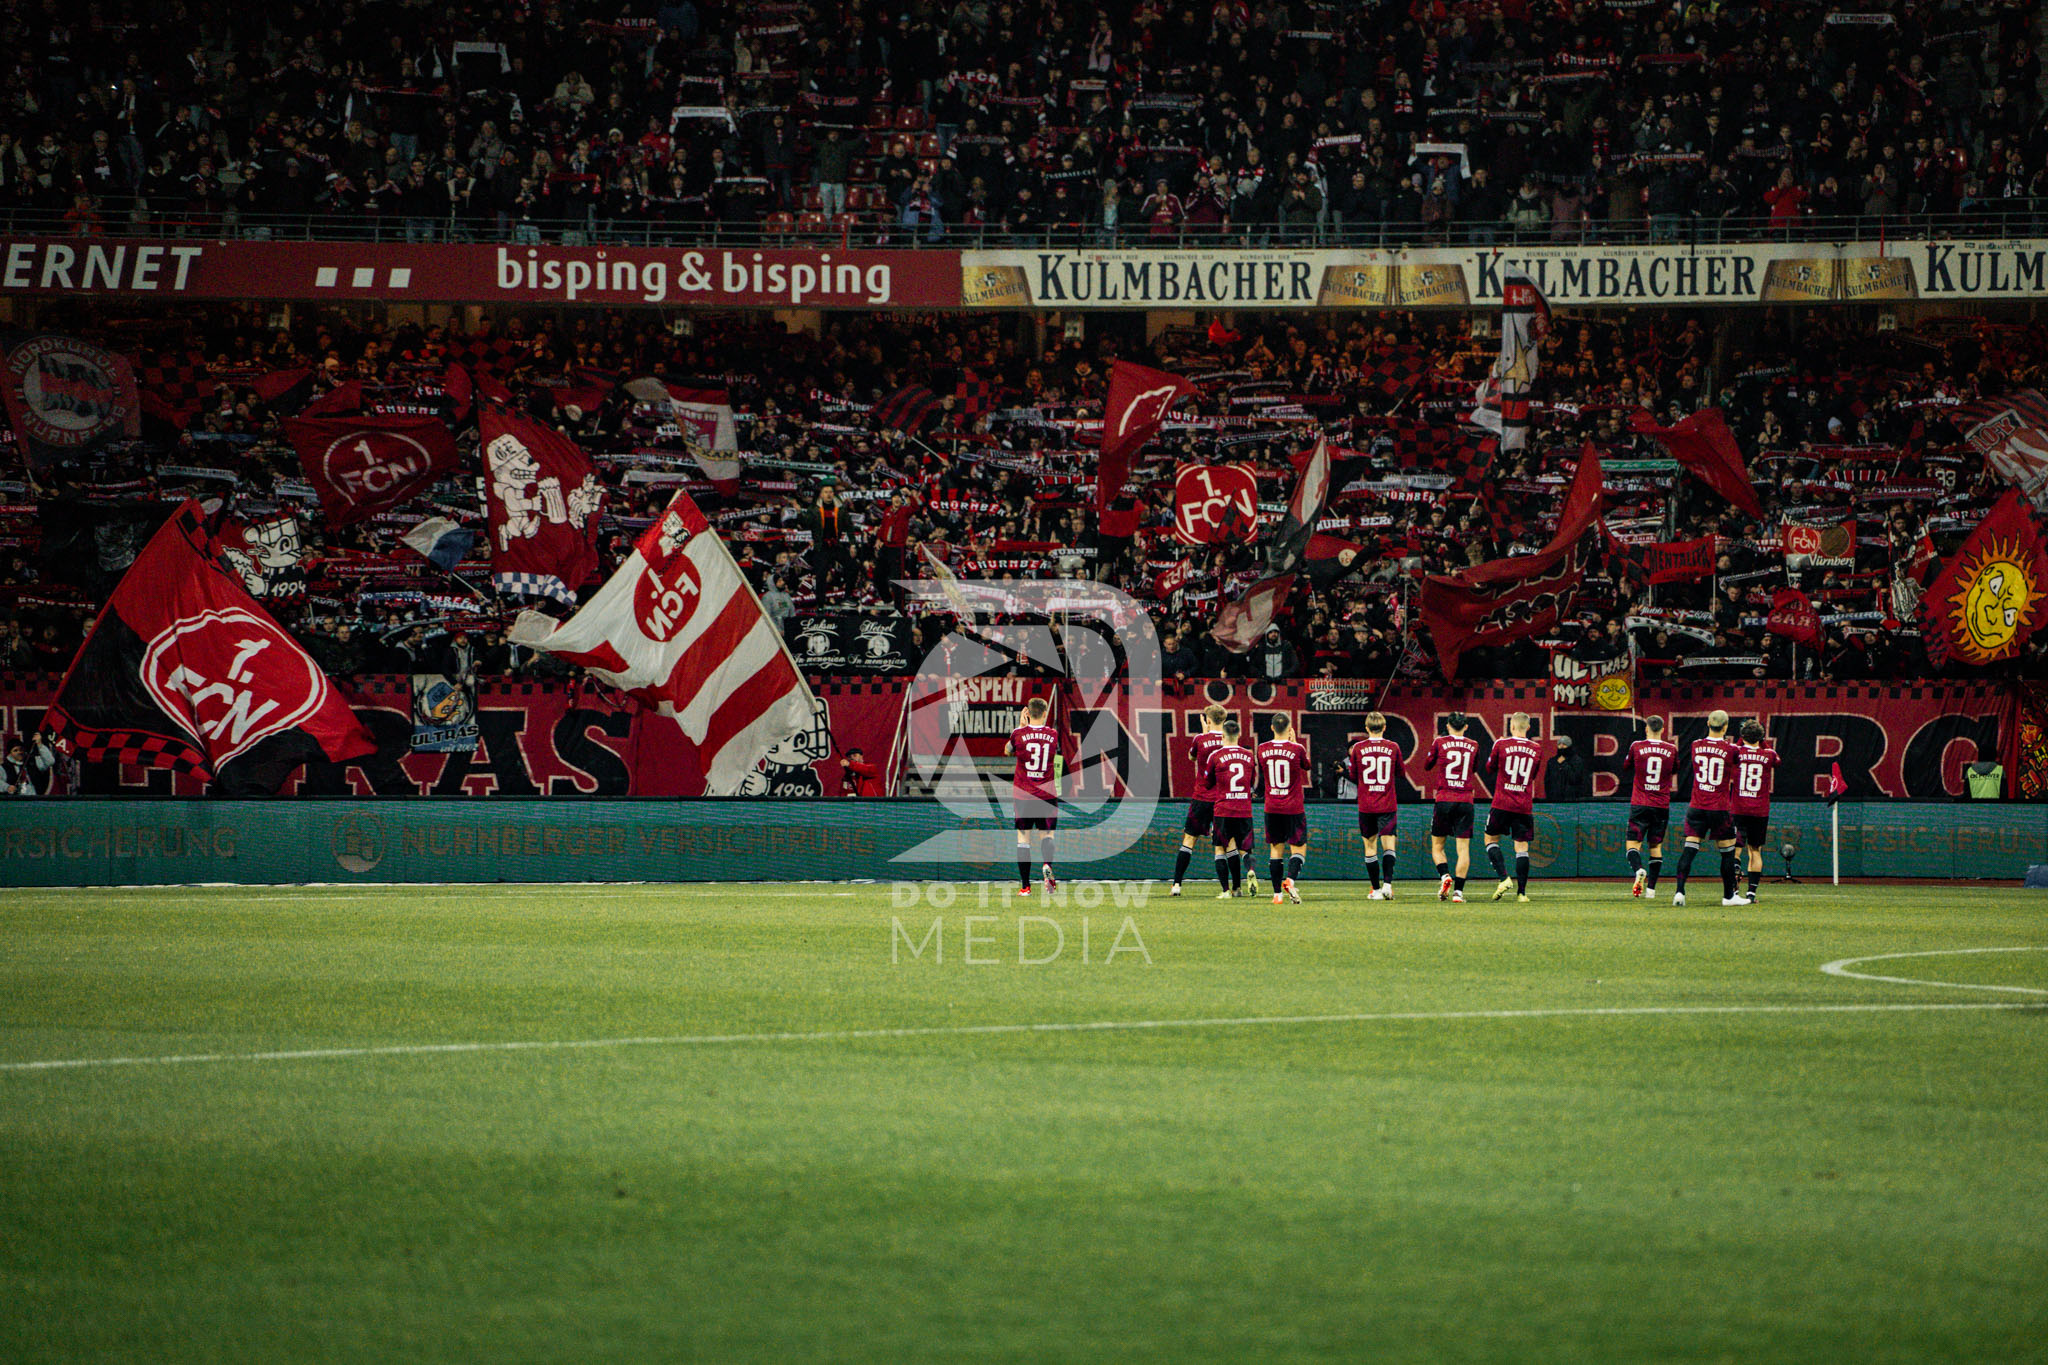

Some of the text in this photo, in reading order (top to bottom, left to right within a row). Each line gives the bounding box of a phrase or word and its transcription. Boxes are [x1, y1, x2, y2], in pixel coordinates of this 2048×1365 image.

[497, 248, 891, 304] bisping & bisping
[1038, 254, 1312, 300] KULMBACHER
[1196, 469, 1223, 497] 1.
[1181, 488, 1256, 535] FCN
[1552, 653, 1630, 681] ULTRAS
[945, 677, 1026, 702] RESPEKT
[1552, 683, 1590, 707] 1994
[410, 724, 479, 747] ULTRAS
[1025, 743, 1050, 771] 31
[1361, 755, 1392, 785] 20
[1445, 750, 1471, 781] 21
[1504, 755, 1534, 785] 44
[1646, 756, 1663, 784] 9
[1694, 755, 1725, 786] 30
[1229, 763, 1245, 792] 2
[1266, 759, 1291, 788] 10
[1739, 762, 1764, 793] 18
